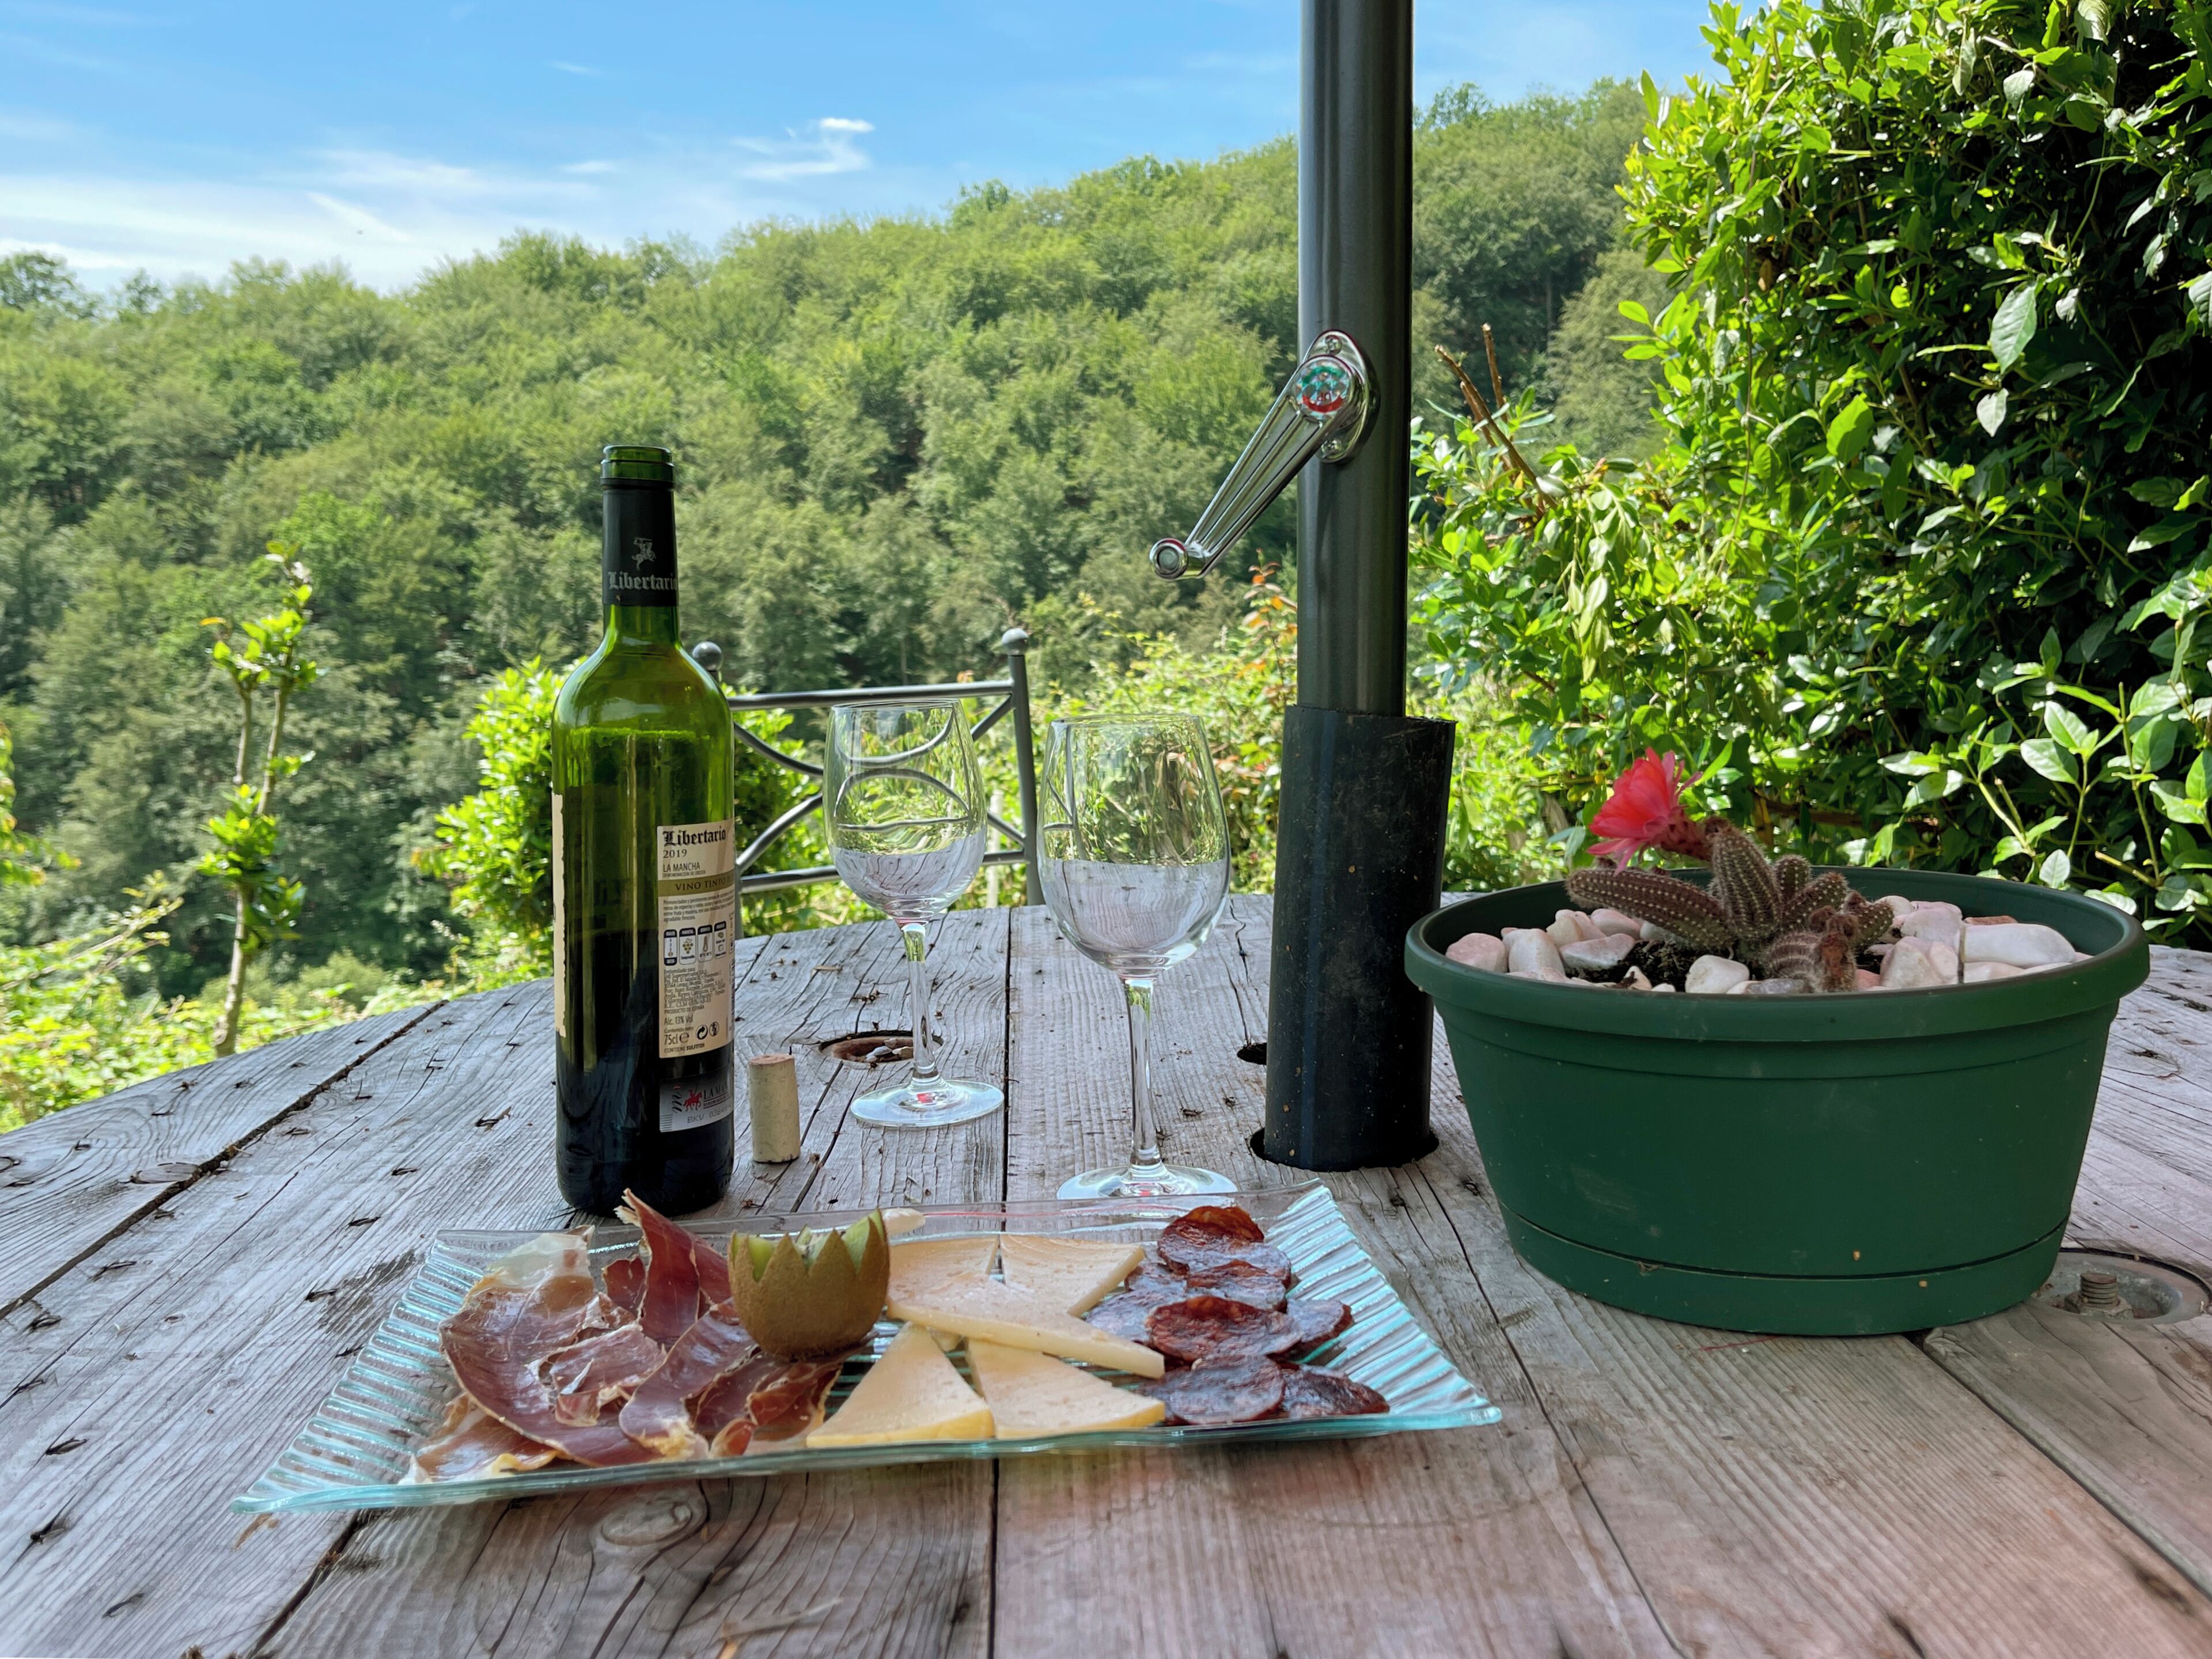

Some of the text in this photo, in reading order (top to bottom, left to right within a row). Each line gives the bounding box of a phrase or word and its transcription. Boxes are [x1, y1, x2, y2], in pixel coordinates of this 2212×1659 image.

[662, 825, 726, 847] Libertario
[663, 849, 687, 858] 2019
[663, 862, 700, 872] LA MANCHA
[675, 882, 701, 891] VINO
[704, 877, 726, 888] TINTO
[664, 1033, 678, 1045] 75cl
[687, 1114, 704, 1123] BKV
